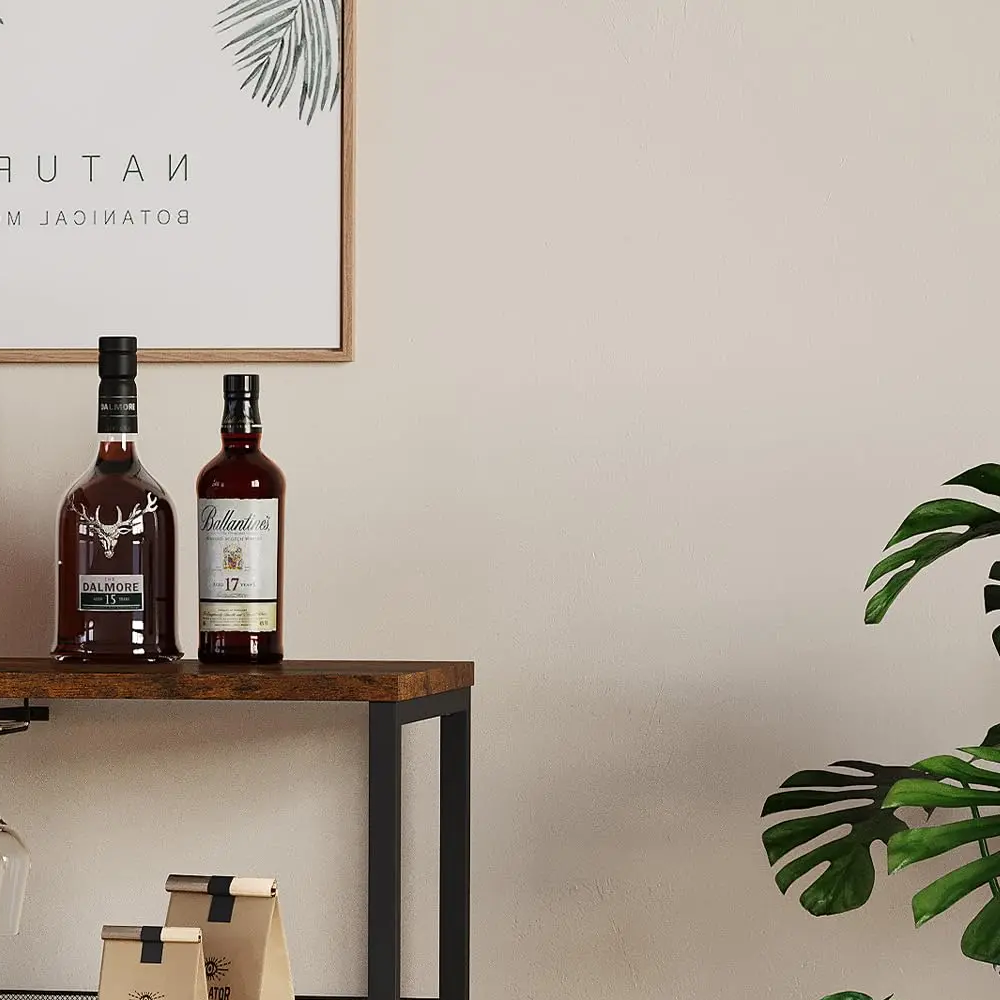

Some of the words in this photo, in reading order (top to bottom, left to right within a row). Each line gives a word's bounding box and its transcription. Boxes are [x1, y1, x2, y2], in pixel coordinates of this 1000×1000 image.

[82, 582, 139, 592] DALMORE
[225, 577, 240, 592] 17
[105, 594, 116, 605] 15
